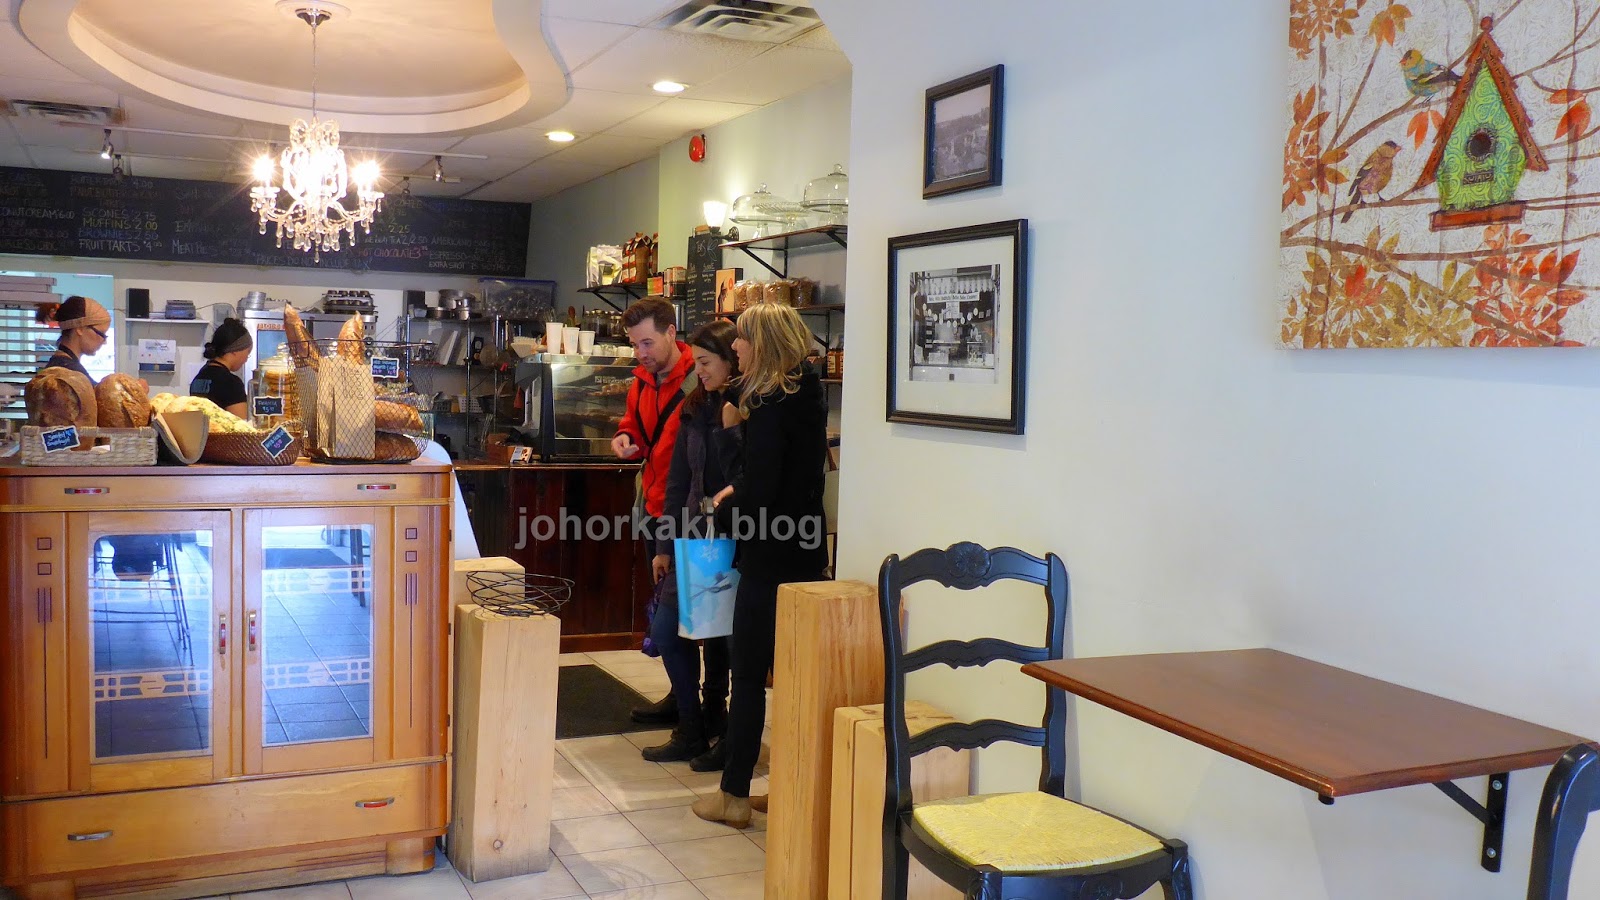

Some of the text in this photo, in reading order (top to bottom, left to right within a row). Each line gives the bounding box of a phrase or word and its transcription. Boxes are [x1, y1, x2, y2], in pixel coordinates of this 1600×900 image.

[82, 207, 129, 219] SCONES
[82, 217, 131, 230] MUFFINS
[78, 228, 132, 241] BROWNIES
[79, 238, 104, 250] FRUIT
[107, 239, 141, 252] TARTS
[428, 261, 448, 269] EXTRA
